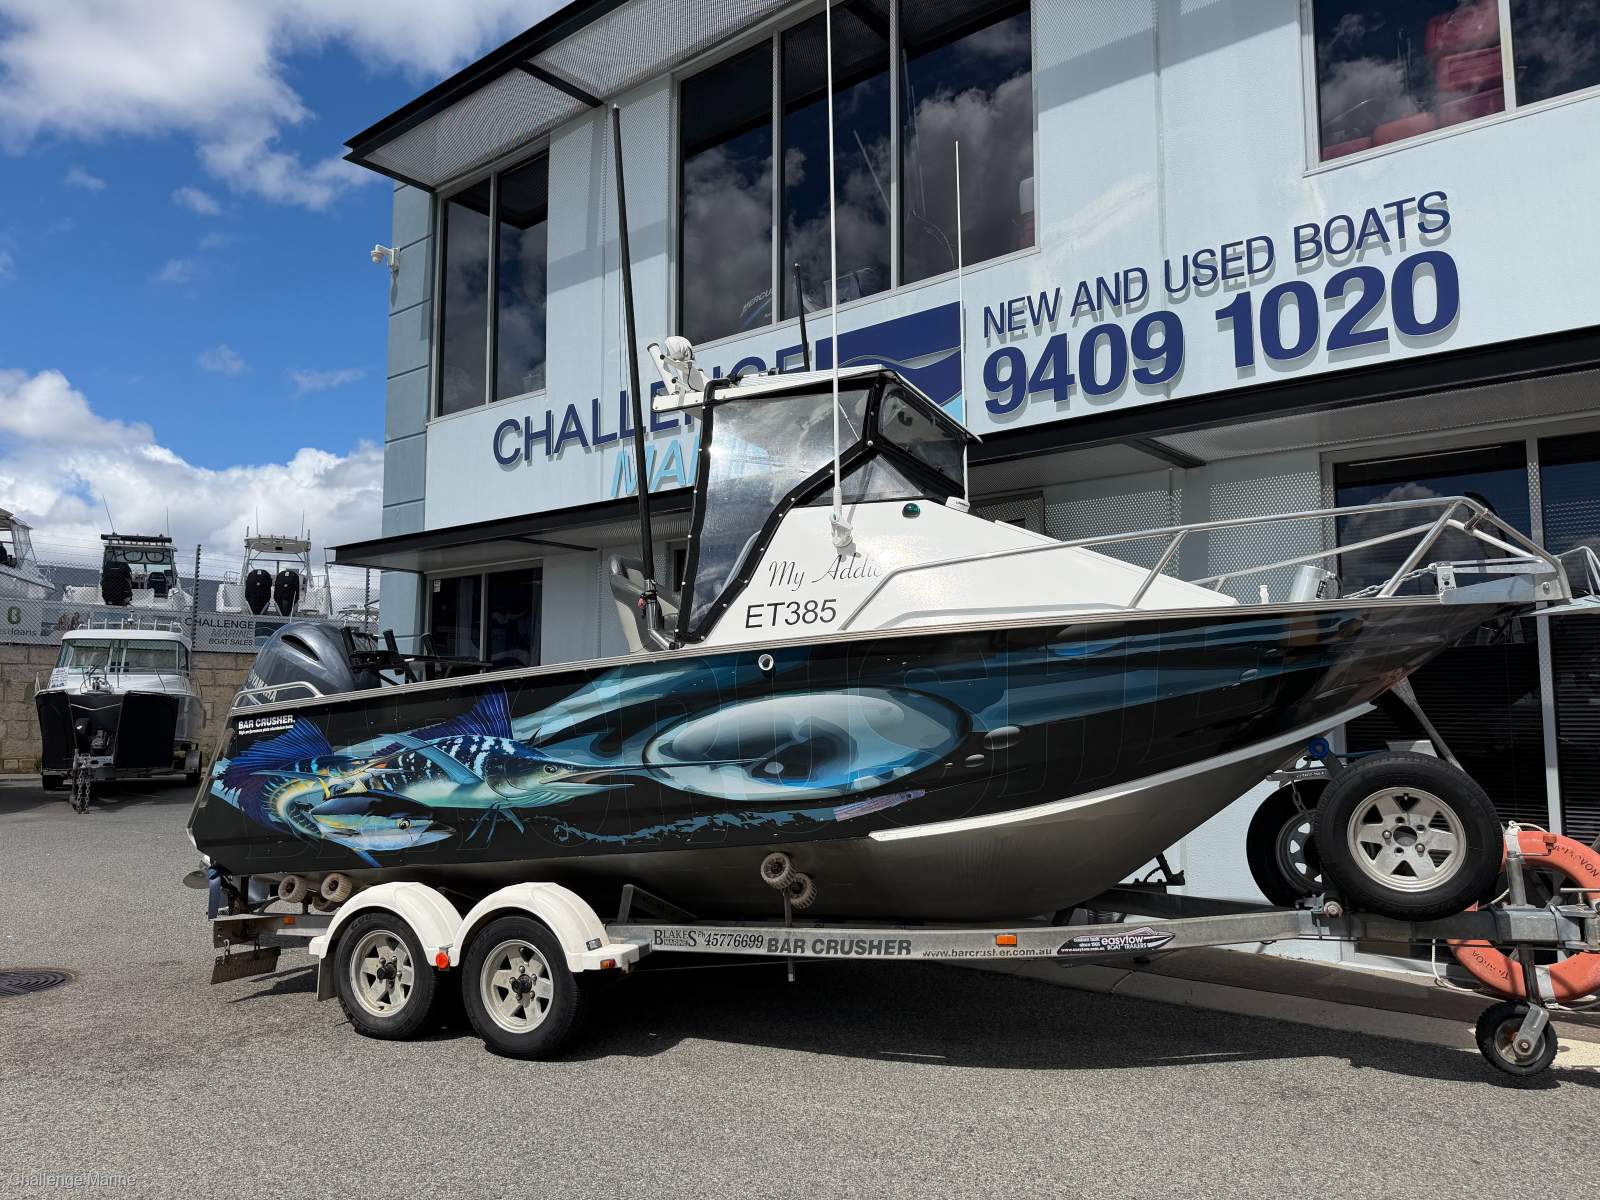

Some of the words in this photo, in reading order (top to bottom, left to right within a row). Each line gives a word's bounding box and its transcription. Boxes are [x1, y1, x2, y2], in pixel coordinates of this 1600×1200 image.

[983, 287, 1061, 338] NEW
[1070, 267, 1148, 317] AND
[1164, 235, 1275, 293] USED
[1293, 190, 1450, 264] BOATS
[741, 287, 773, 313] MERCU
[983, 310, 1184, 415] 9409
[1215, 250, 1460, 368] 1020
[768, 560, 805, 591] My
[185, 617, 255, 629] CHALLENGE
[745, 599, 837, 628] ET385
[238, 720, 254, 730] BAR
[255, 714, 294, 727] CRUSHER
[704, 933, 765, 949] 45776699
[766, 937, 806, 954] BAR
[811, 938, 912, 956] CRUSHER
